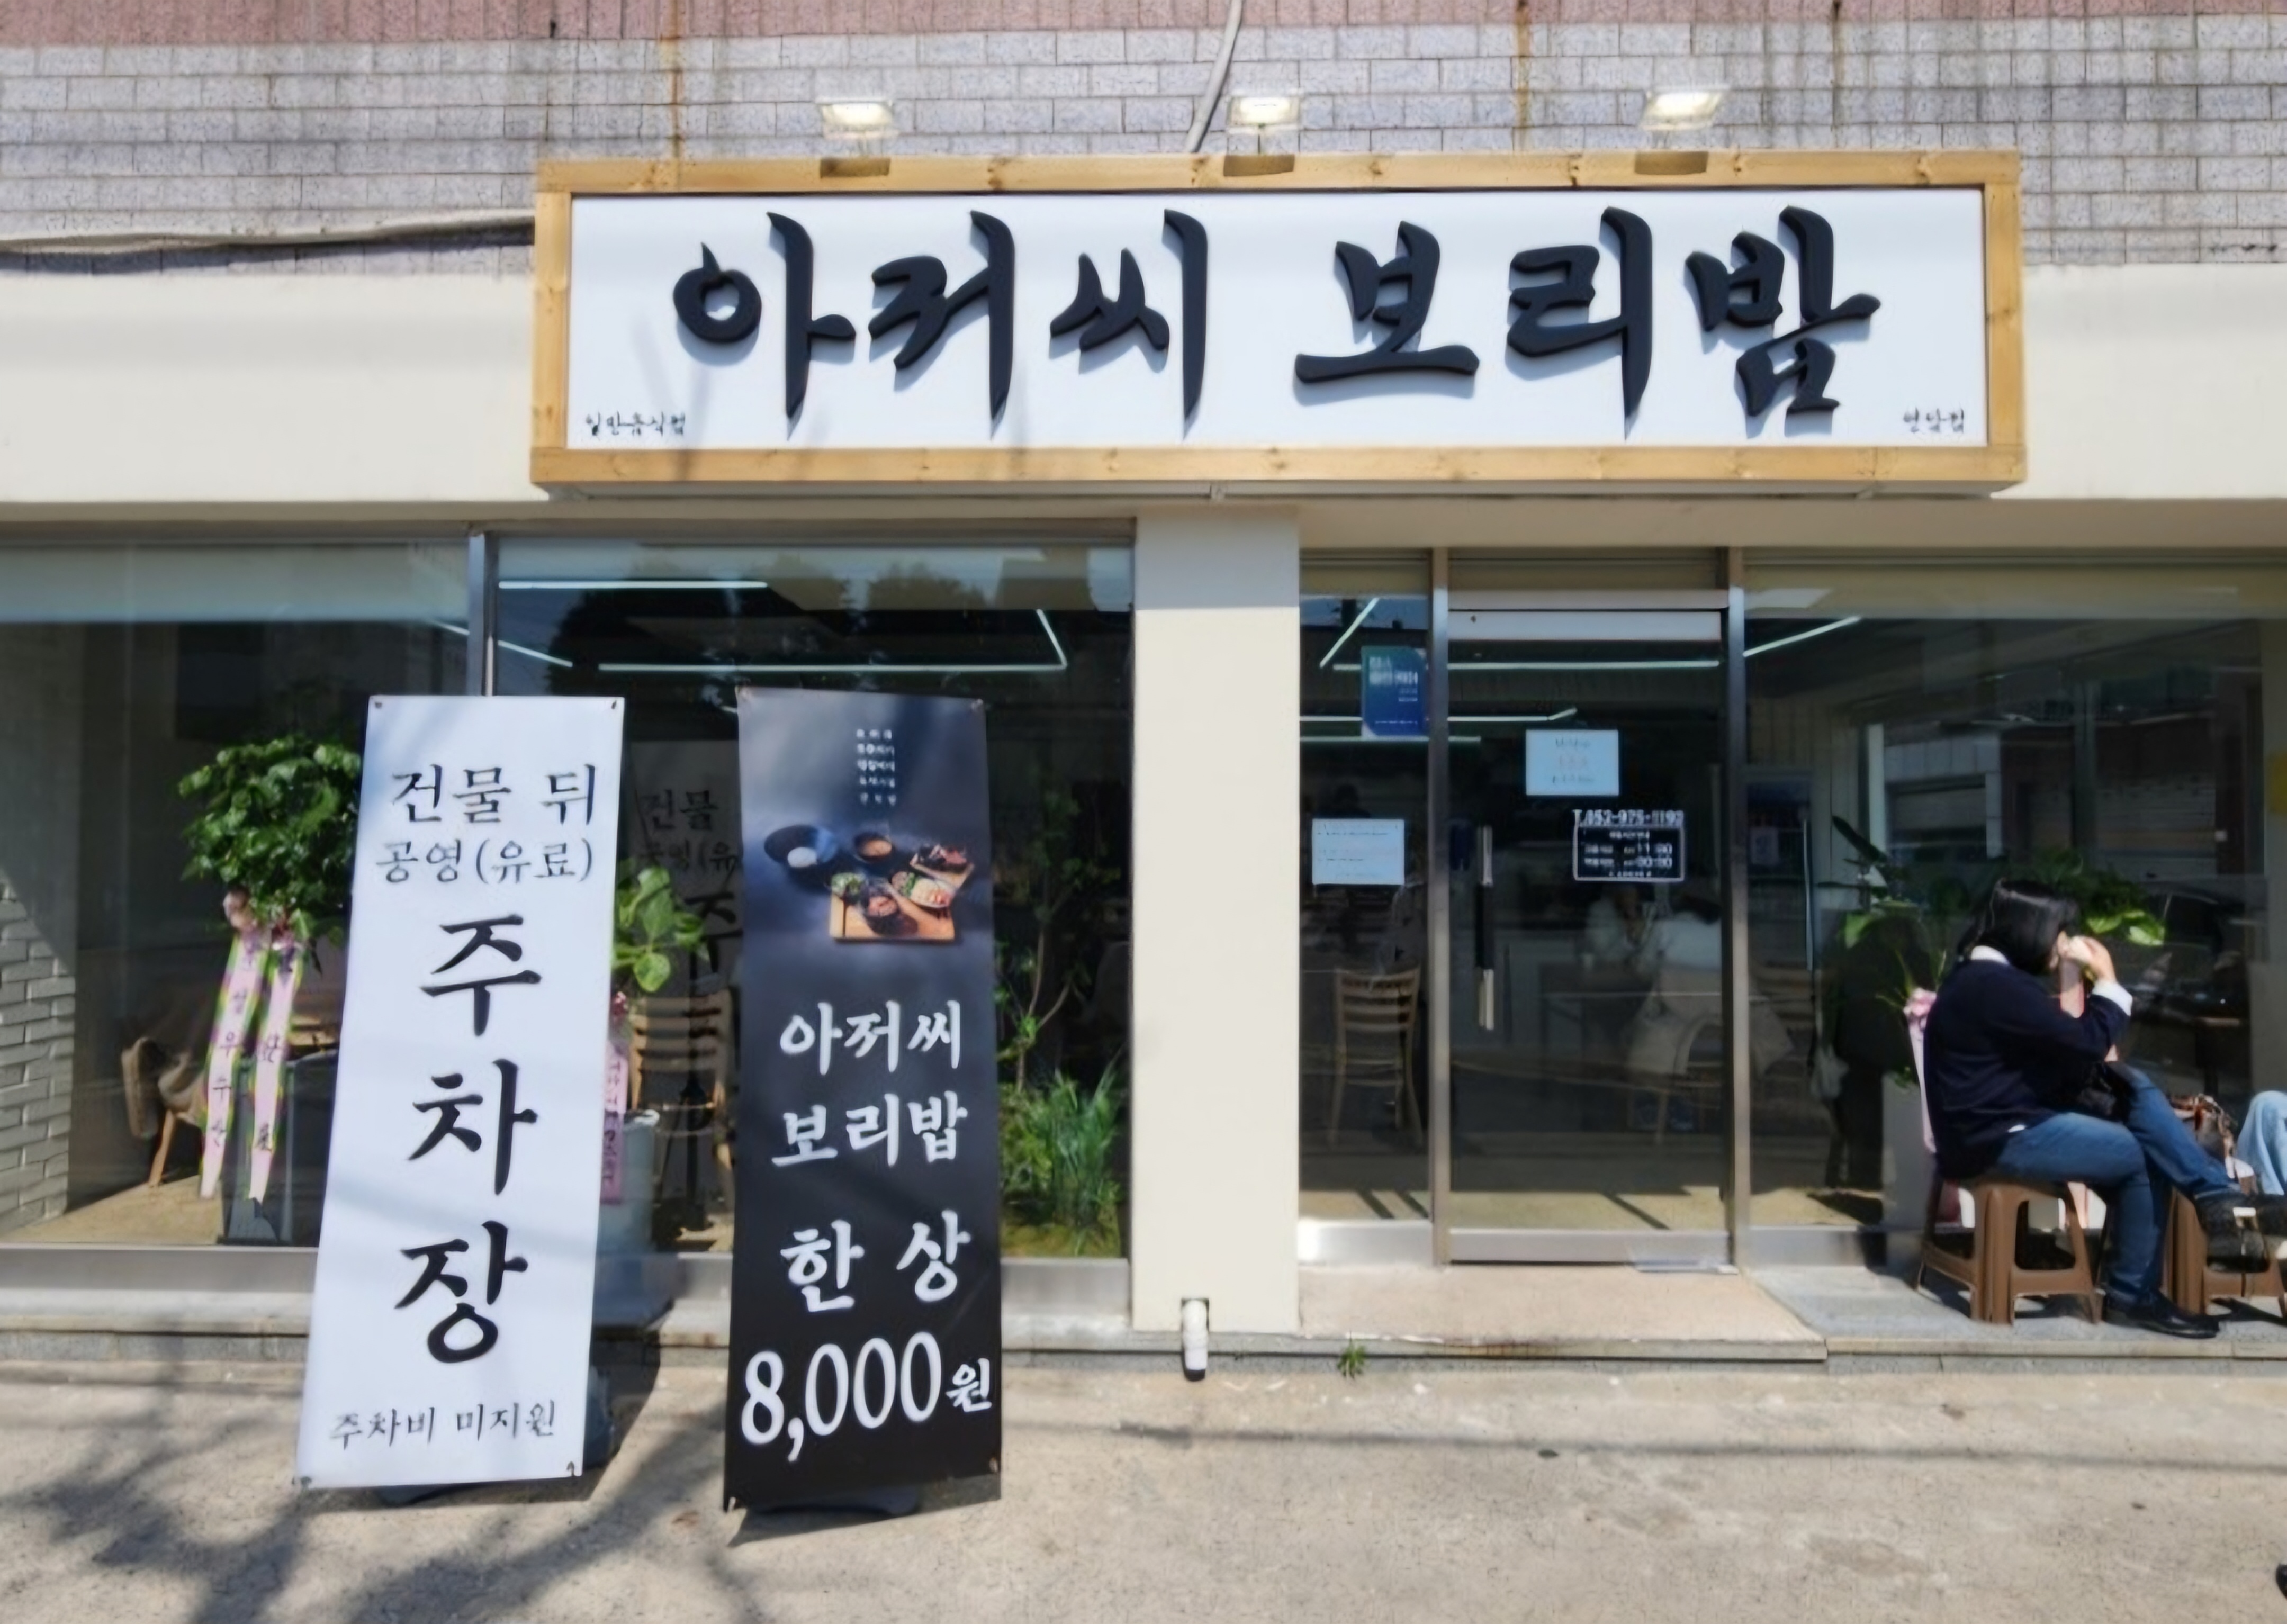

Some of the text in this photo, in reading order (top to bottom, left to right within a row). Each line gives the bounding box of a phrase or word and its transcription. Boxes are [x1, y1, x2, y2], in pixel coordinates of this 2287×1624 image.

[1294, 206, 1880, 420] 보리밥
[392, 764, 596, 825] 건물 뒤
[376, 838, 592, 883] 공영(유료)
[395, 914, 542, 1364] 주차장
[771, 1090, 968, 1167] 보리밥
[329, 1400, 555, 1450] 주차비 미지원
[741, 1331, 992, 1462] 8,000원
